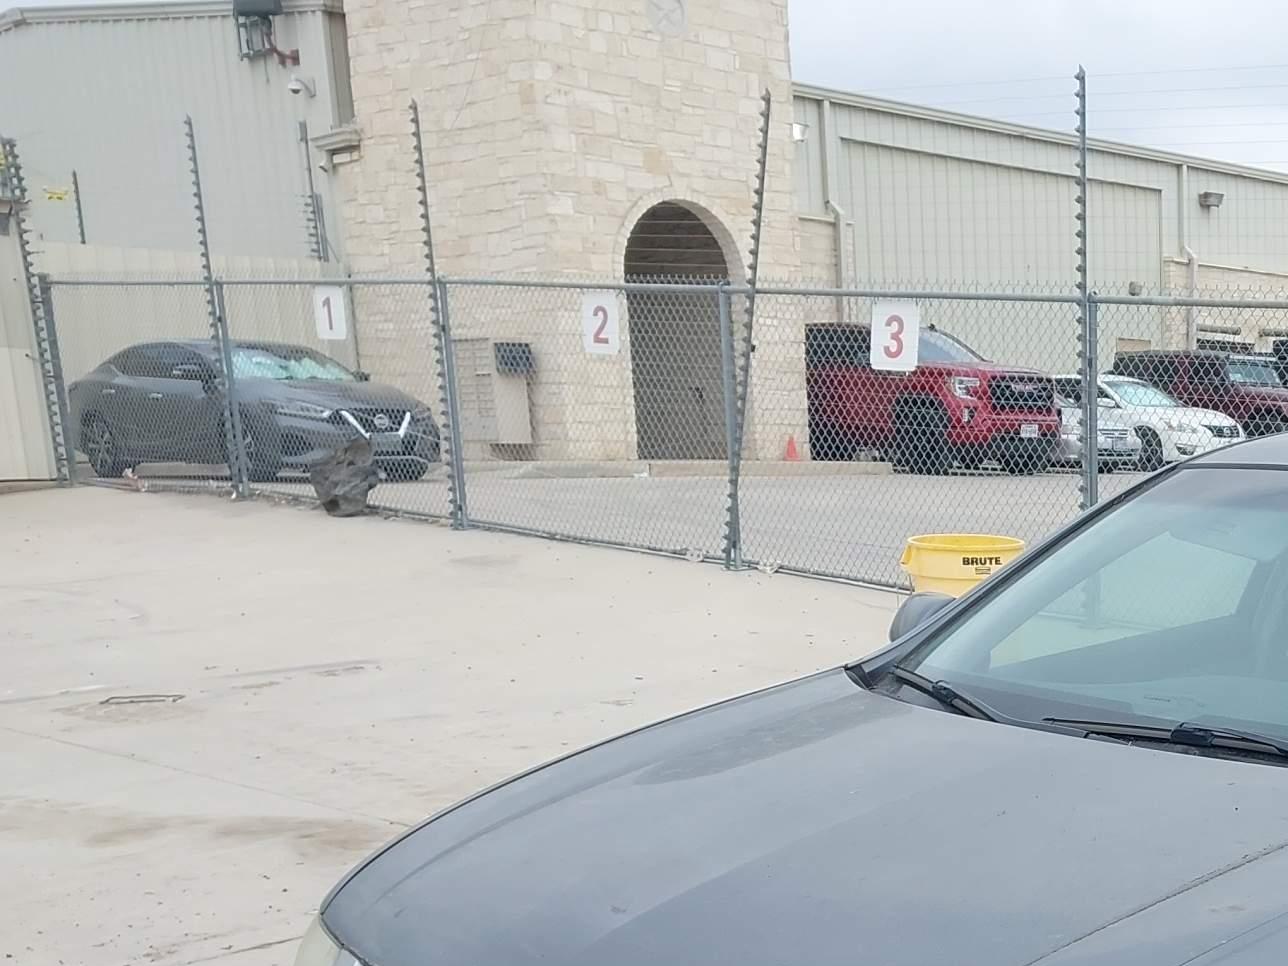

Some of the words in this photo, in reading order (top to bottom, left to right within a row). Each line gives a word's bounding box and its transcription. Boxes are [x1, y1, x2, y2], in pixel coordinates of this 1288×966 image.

[321, 296, 334, 331] 1
[593, 305, 609, 344] 2
[883, 314, 905, 359] 3
[962, 556, 1003, 566] BRUTE
